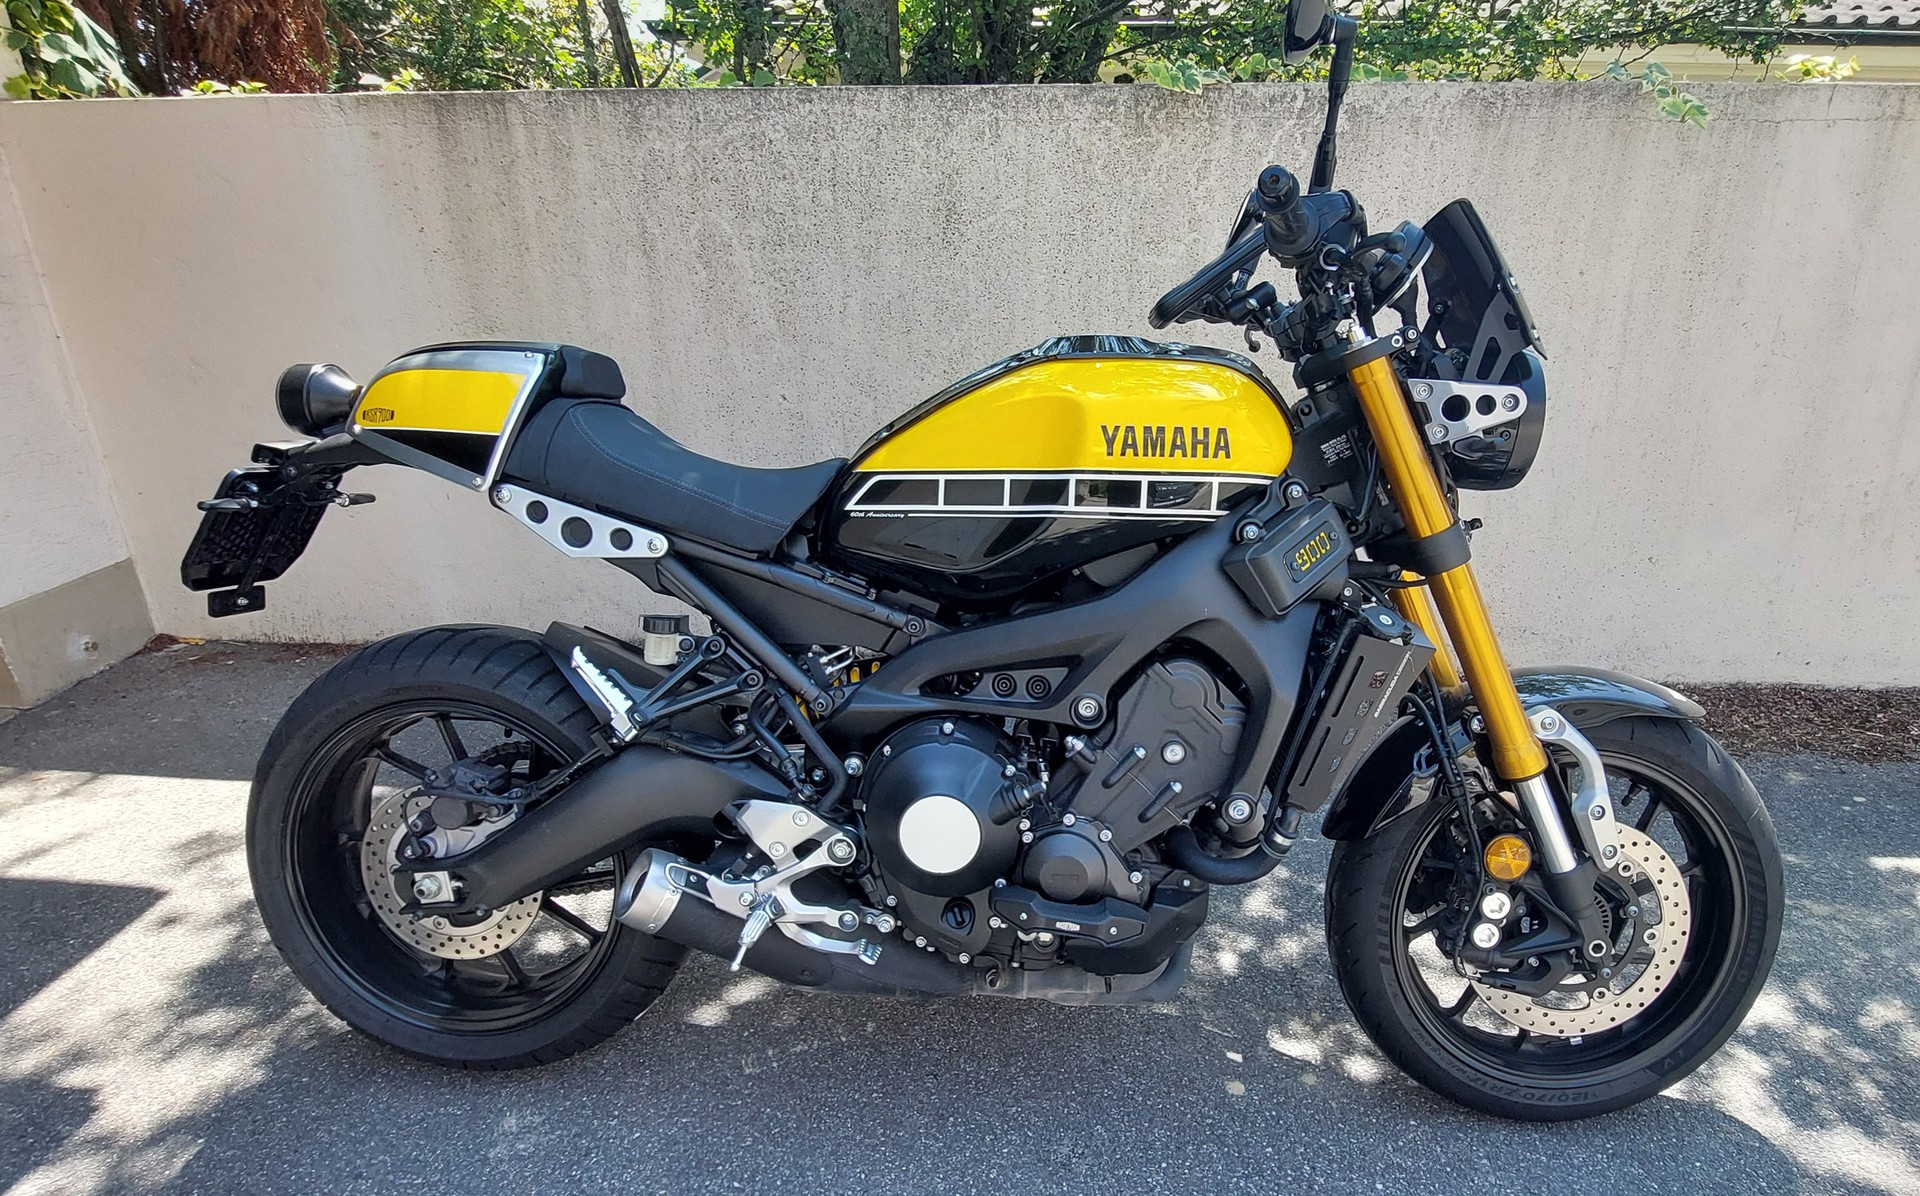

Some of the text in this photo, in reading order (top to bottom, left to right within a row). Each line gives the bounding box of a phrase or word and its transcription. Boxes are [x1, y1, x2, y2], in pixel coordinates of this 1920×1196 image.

[1101, 425, 1231, 459] YAMAHA
[865, 511, 905, 519] Anniversary
[1295, 531, 1331, 572] 900
[1373, 675, 1399, 718] BARRACUDA
[1522, 1091, 1590, 1103] 120/70
